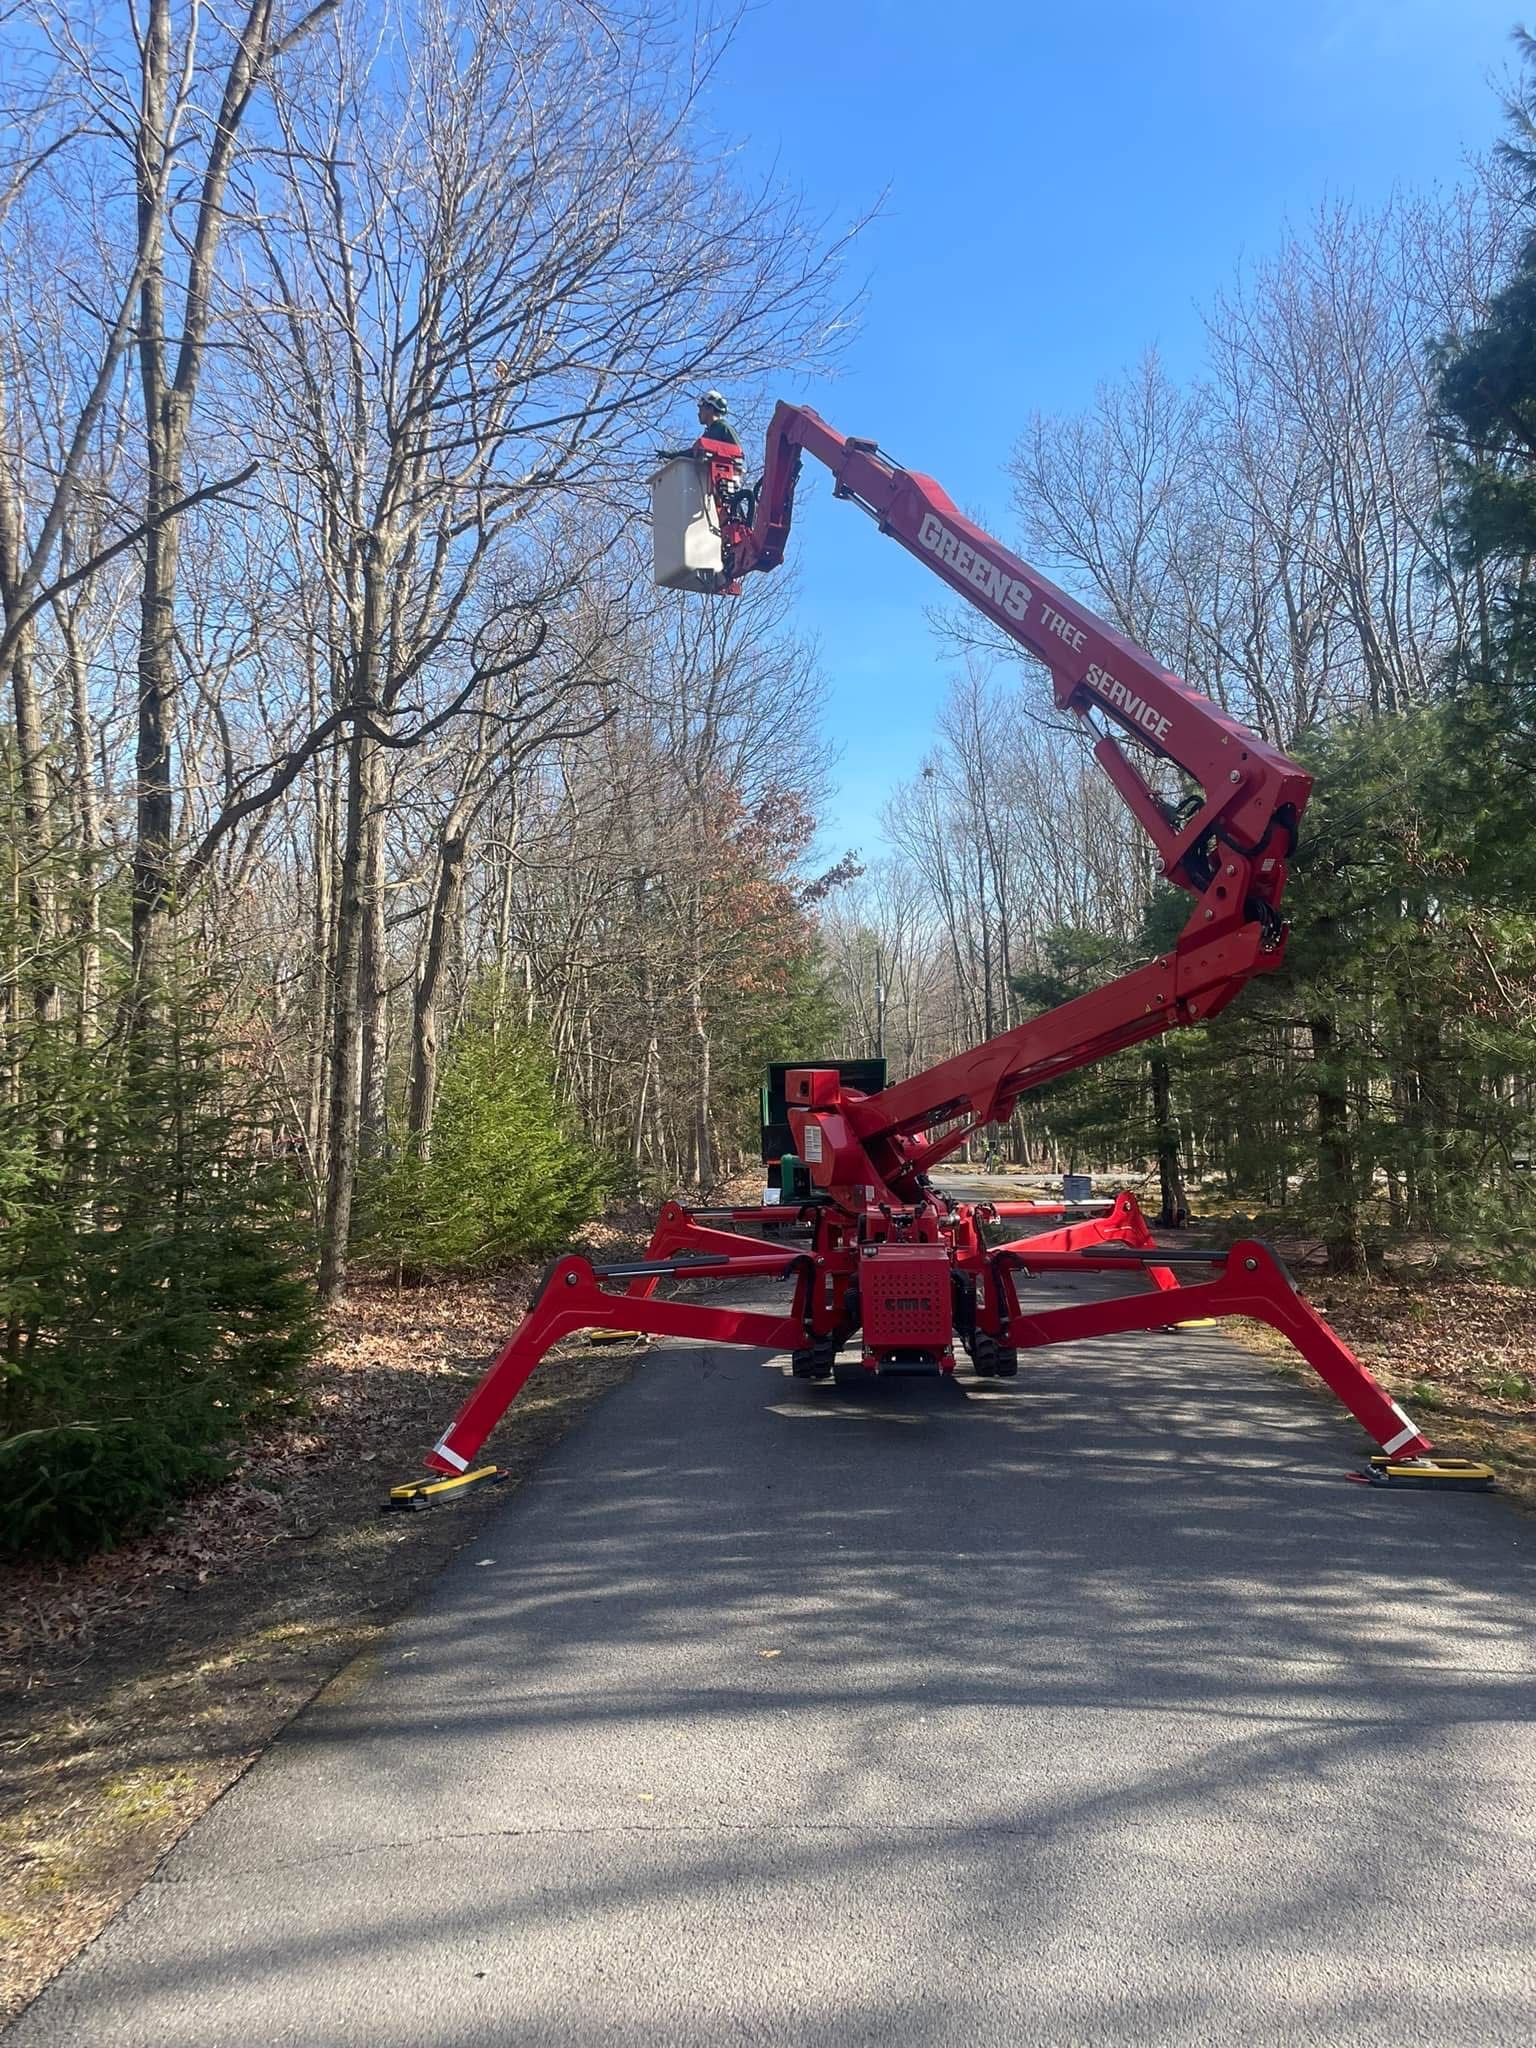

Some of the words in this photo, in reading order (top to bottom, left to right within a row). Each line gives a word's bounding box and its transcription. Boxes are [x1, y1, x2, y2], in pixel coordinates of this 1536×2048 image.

[918, 513, 1033, 621] GREENS
[1041, 603, 1088, 653] TREE
[1086, 663, 1172, 741] SERVICE
